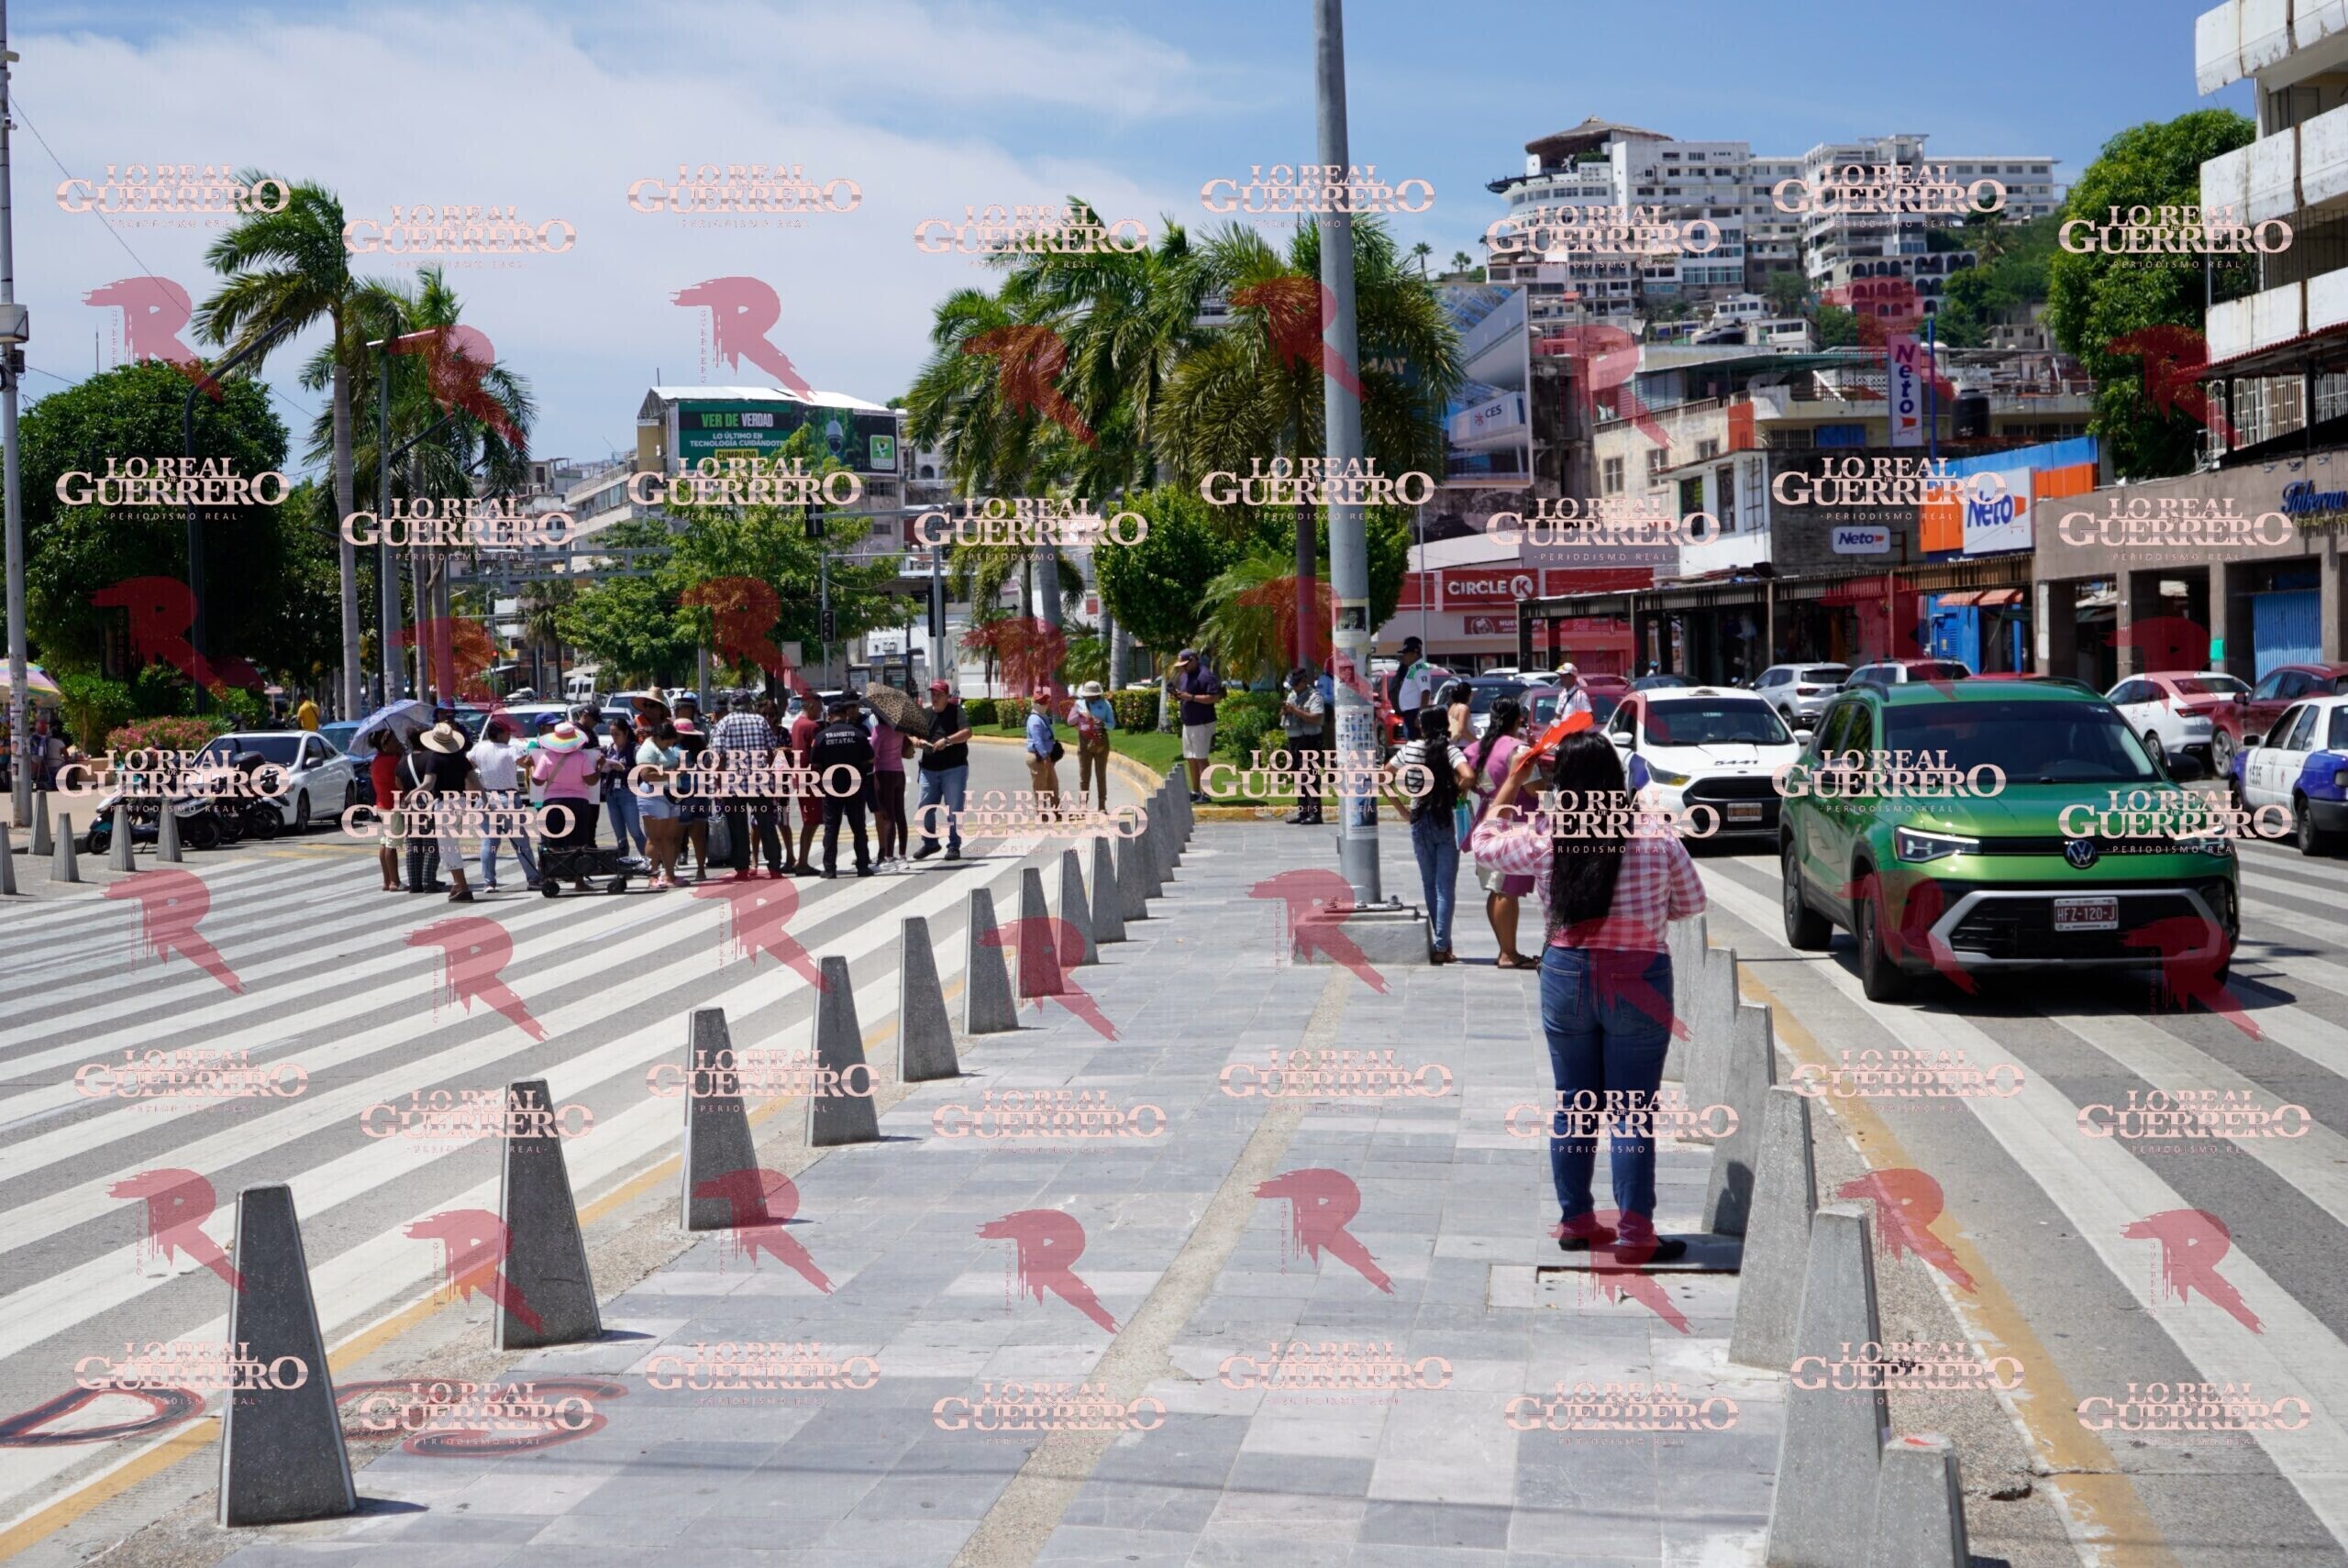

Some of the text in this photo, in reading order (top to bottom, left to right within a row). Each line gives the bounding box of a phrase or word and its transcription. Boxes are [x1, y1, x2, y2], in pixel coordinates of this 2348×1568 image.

[1895, 345, 1915, 414] Neto
[1485, 404, 1502, 418] CES
[701, 413, 773, 427] VER DE VERDAD
[690, 438, 738, 447] TECNOLOGÍA
[724, 431, 752, 440] ÚLTIMO
[1838, 531, 1874, 546] Neto
[1447, 578, 1533, 599] CIRCLE K
[2056, 907, 2115, 922] HFZ-120-J
